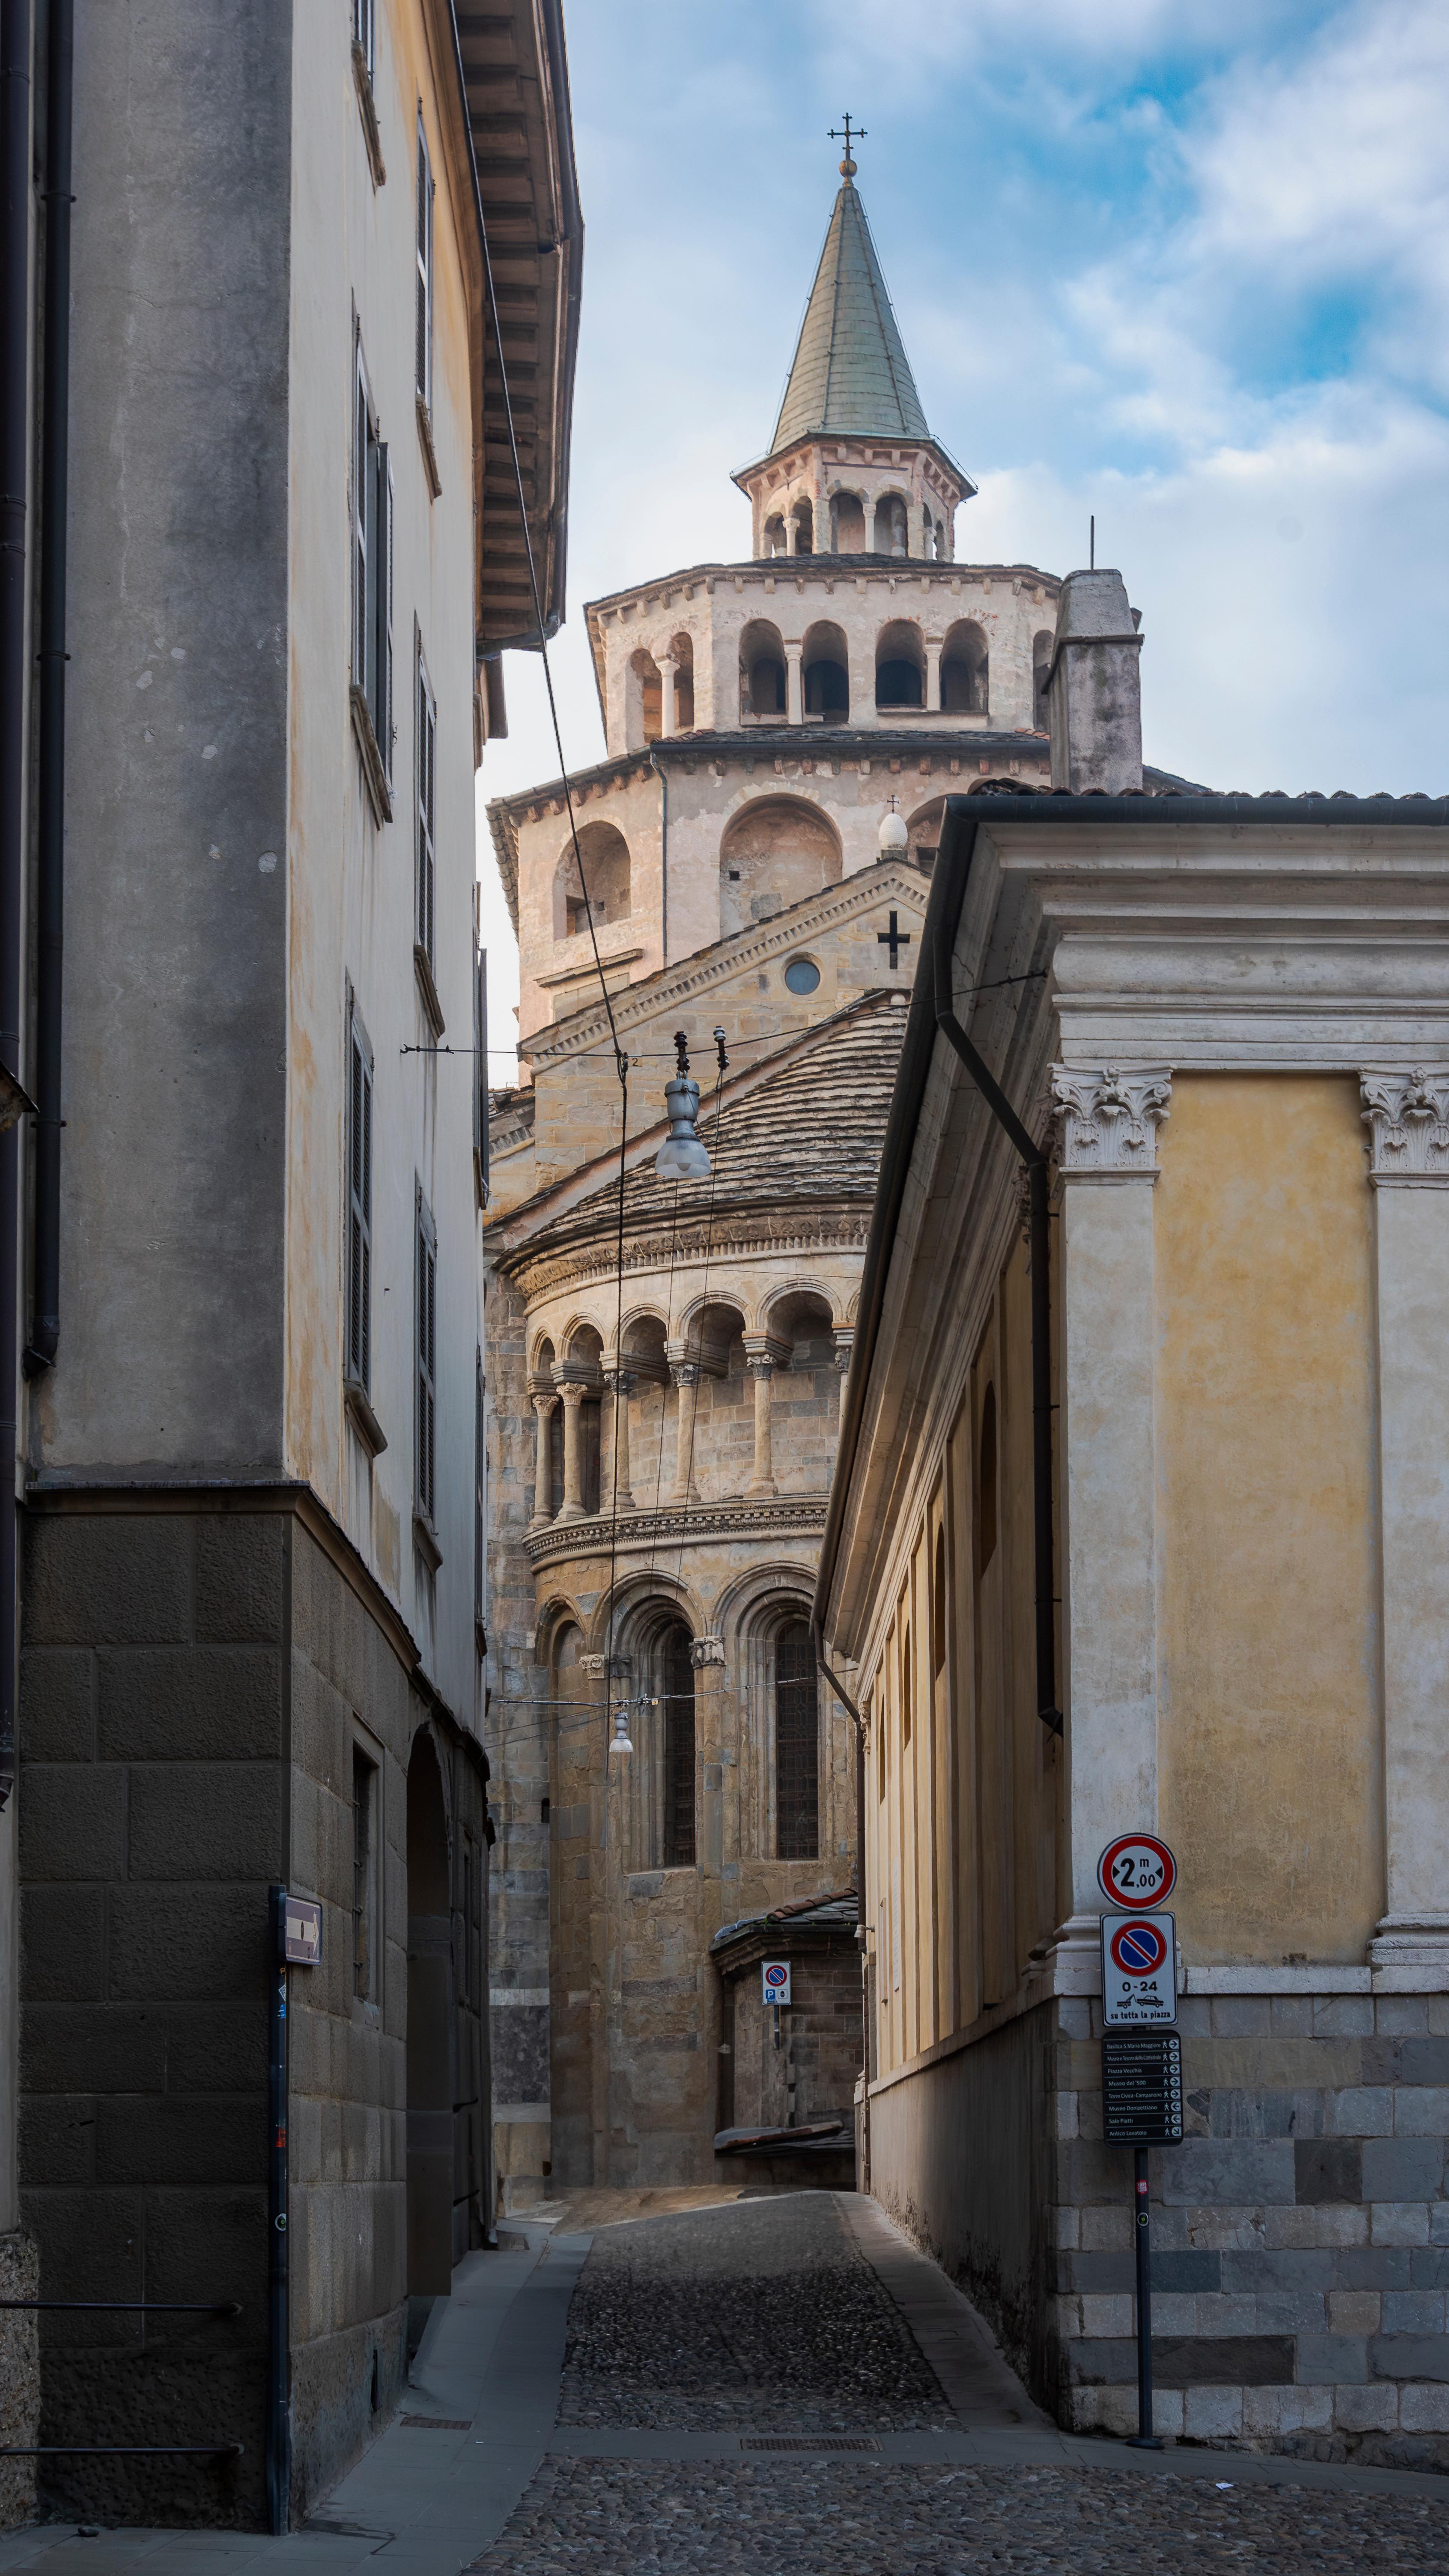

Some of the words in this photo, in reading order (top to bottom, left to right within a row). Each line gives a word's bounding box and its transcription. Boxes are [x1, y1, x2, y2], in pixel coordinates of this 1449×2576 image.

[1139, 1858, 1149, 1867] m
[1141, 2010, 1148, 2018] la
[1150, 2010, 1171, 2020] piazza
